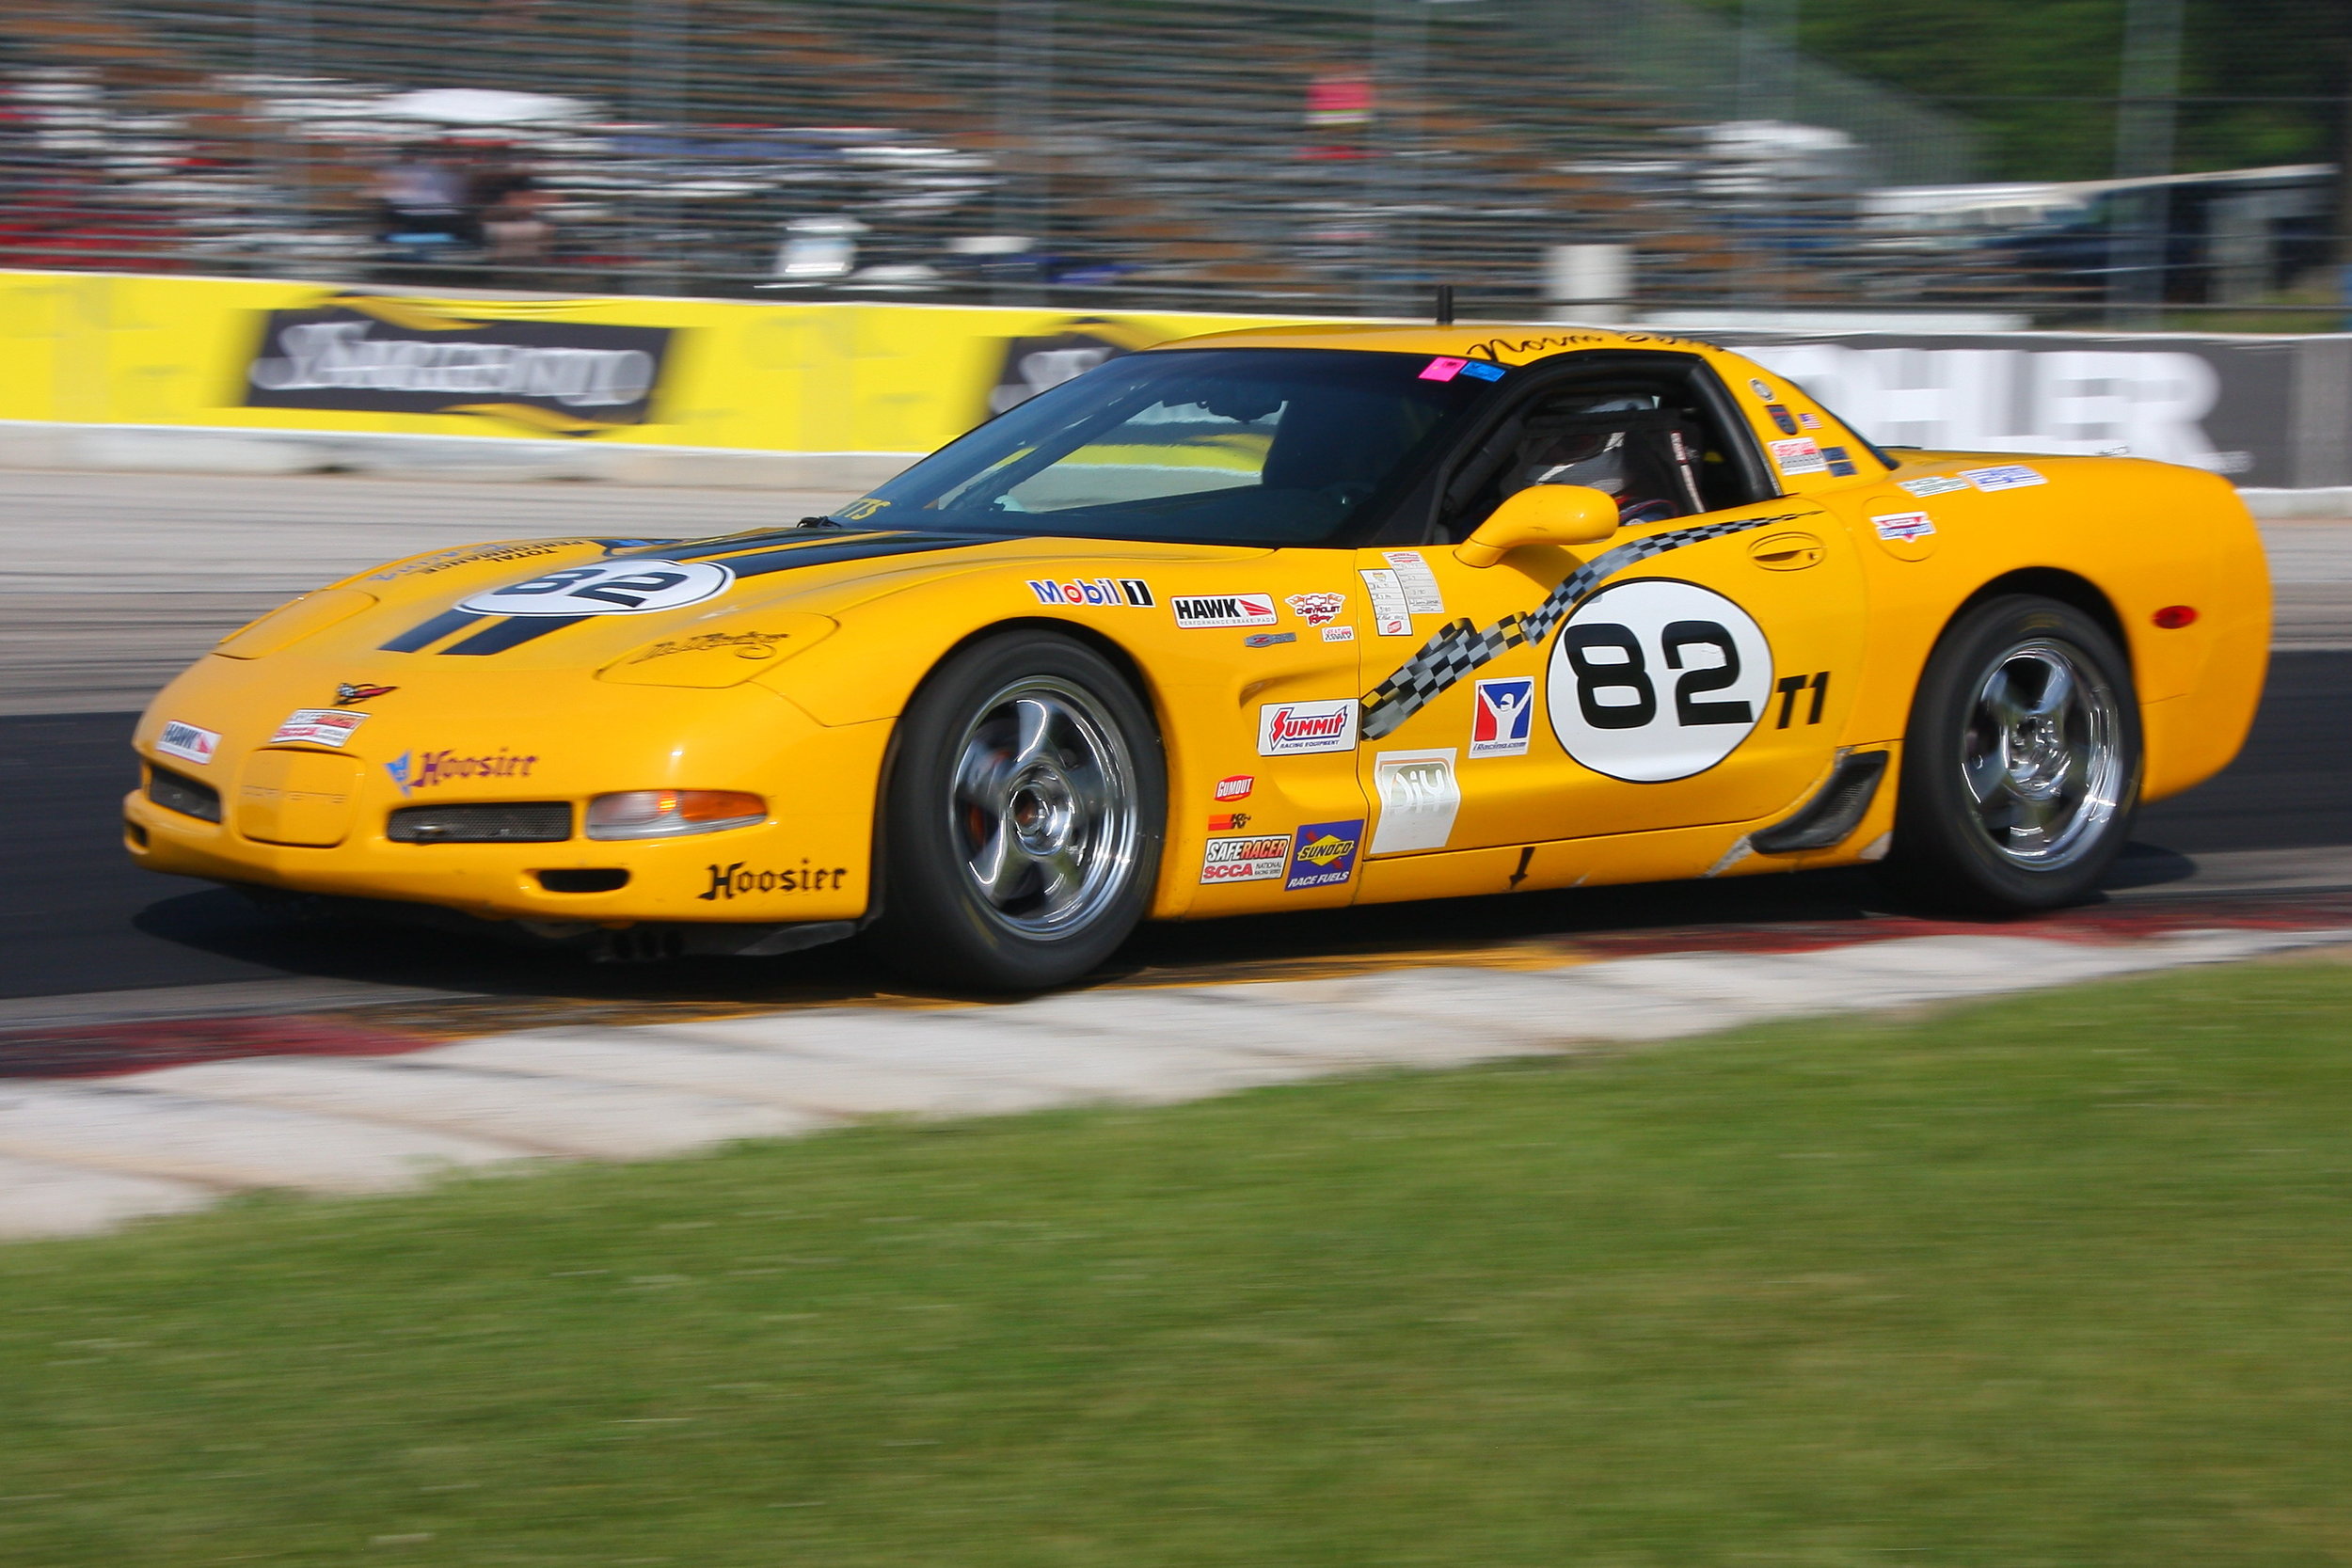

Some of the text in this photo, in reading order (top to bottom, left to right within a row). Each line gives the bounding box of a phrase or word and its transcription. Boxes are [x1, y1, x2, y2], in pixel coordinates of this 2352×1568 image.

[483, 547, 559, 562] TOTAL
[492, 569, 690, 609] 82
[1027, 578, 1123, 605] Mobil
[1174, 599, 1241, 619] HAWK
[1564, 620, 1831, 730] 82 T1
[408, 747, 538, 788] Hoosier
[1216, 778, 1253, 798] GUMOUT
[1298, 842, 1353, 860] SUNOCO
[694, 857, 849, 901] Hoosier
[1203, 863, 1253, 879] SCCA
[1287, 871, 1350, 889] RACE FUELS
